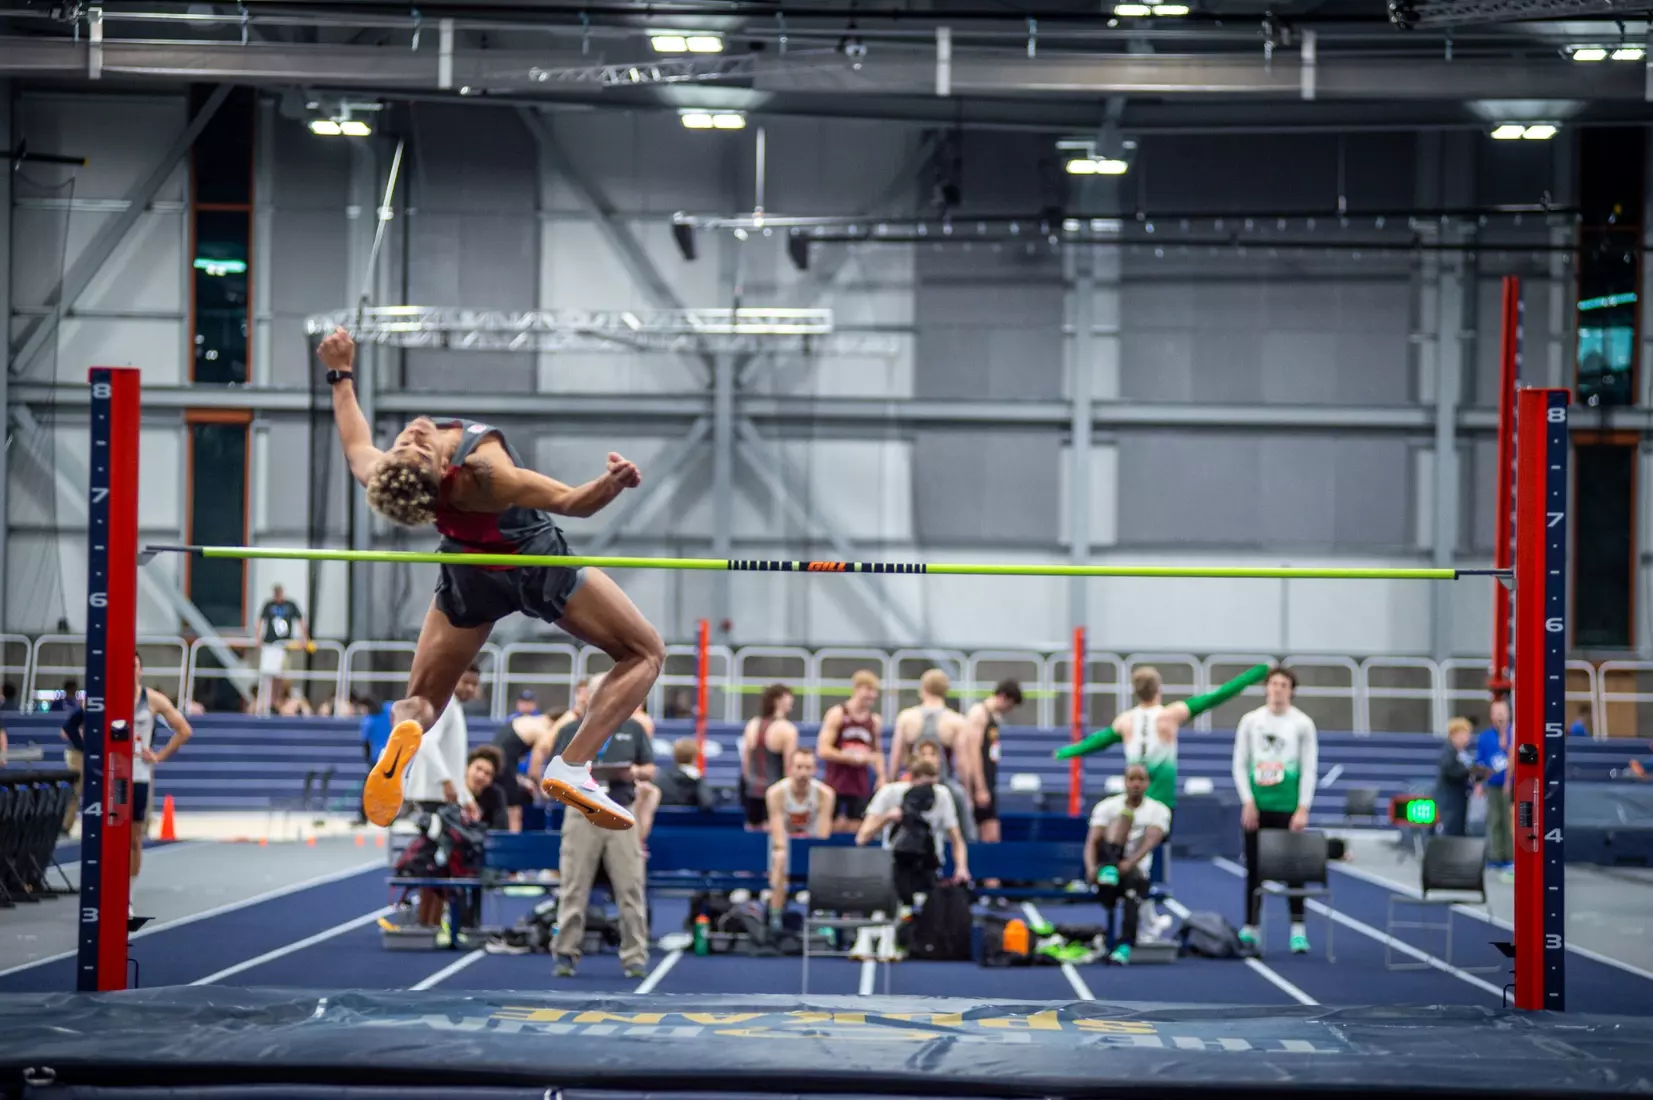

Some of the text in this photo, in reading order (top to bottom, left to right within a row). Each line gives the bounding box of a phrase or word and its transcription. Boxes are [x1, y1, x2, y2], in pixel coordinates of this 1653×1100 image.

[92, 383, 112, 399] 8
[1547, 407, 1567, 423] 8
[91, 487, 110, 504] 7
[1546, 512, 1565, 527] 7
[807, 561, 846, 572] GILL
[89, 592, 108, 607] 6
[1545, 617, 1564, 632] 6
[87, 697, 105, 712] 5
[1545, 722, 1563, 738] 5
[84, 802, 104, 817] 4
[1544, 828, 1563, 843] 4
[82, 907, 99, 923] 3
[1545, 934, 1562, 949] 3
